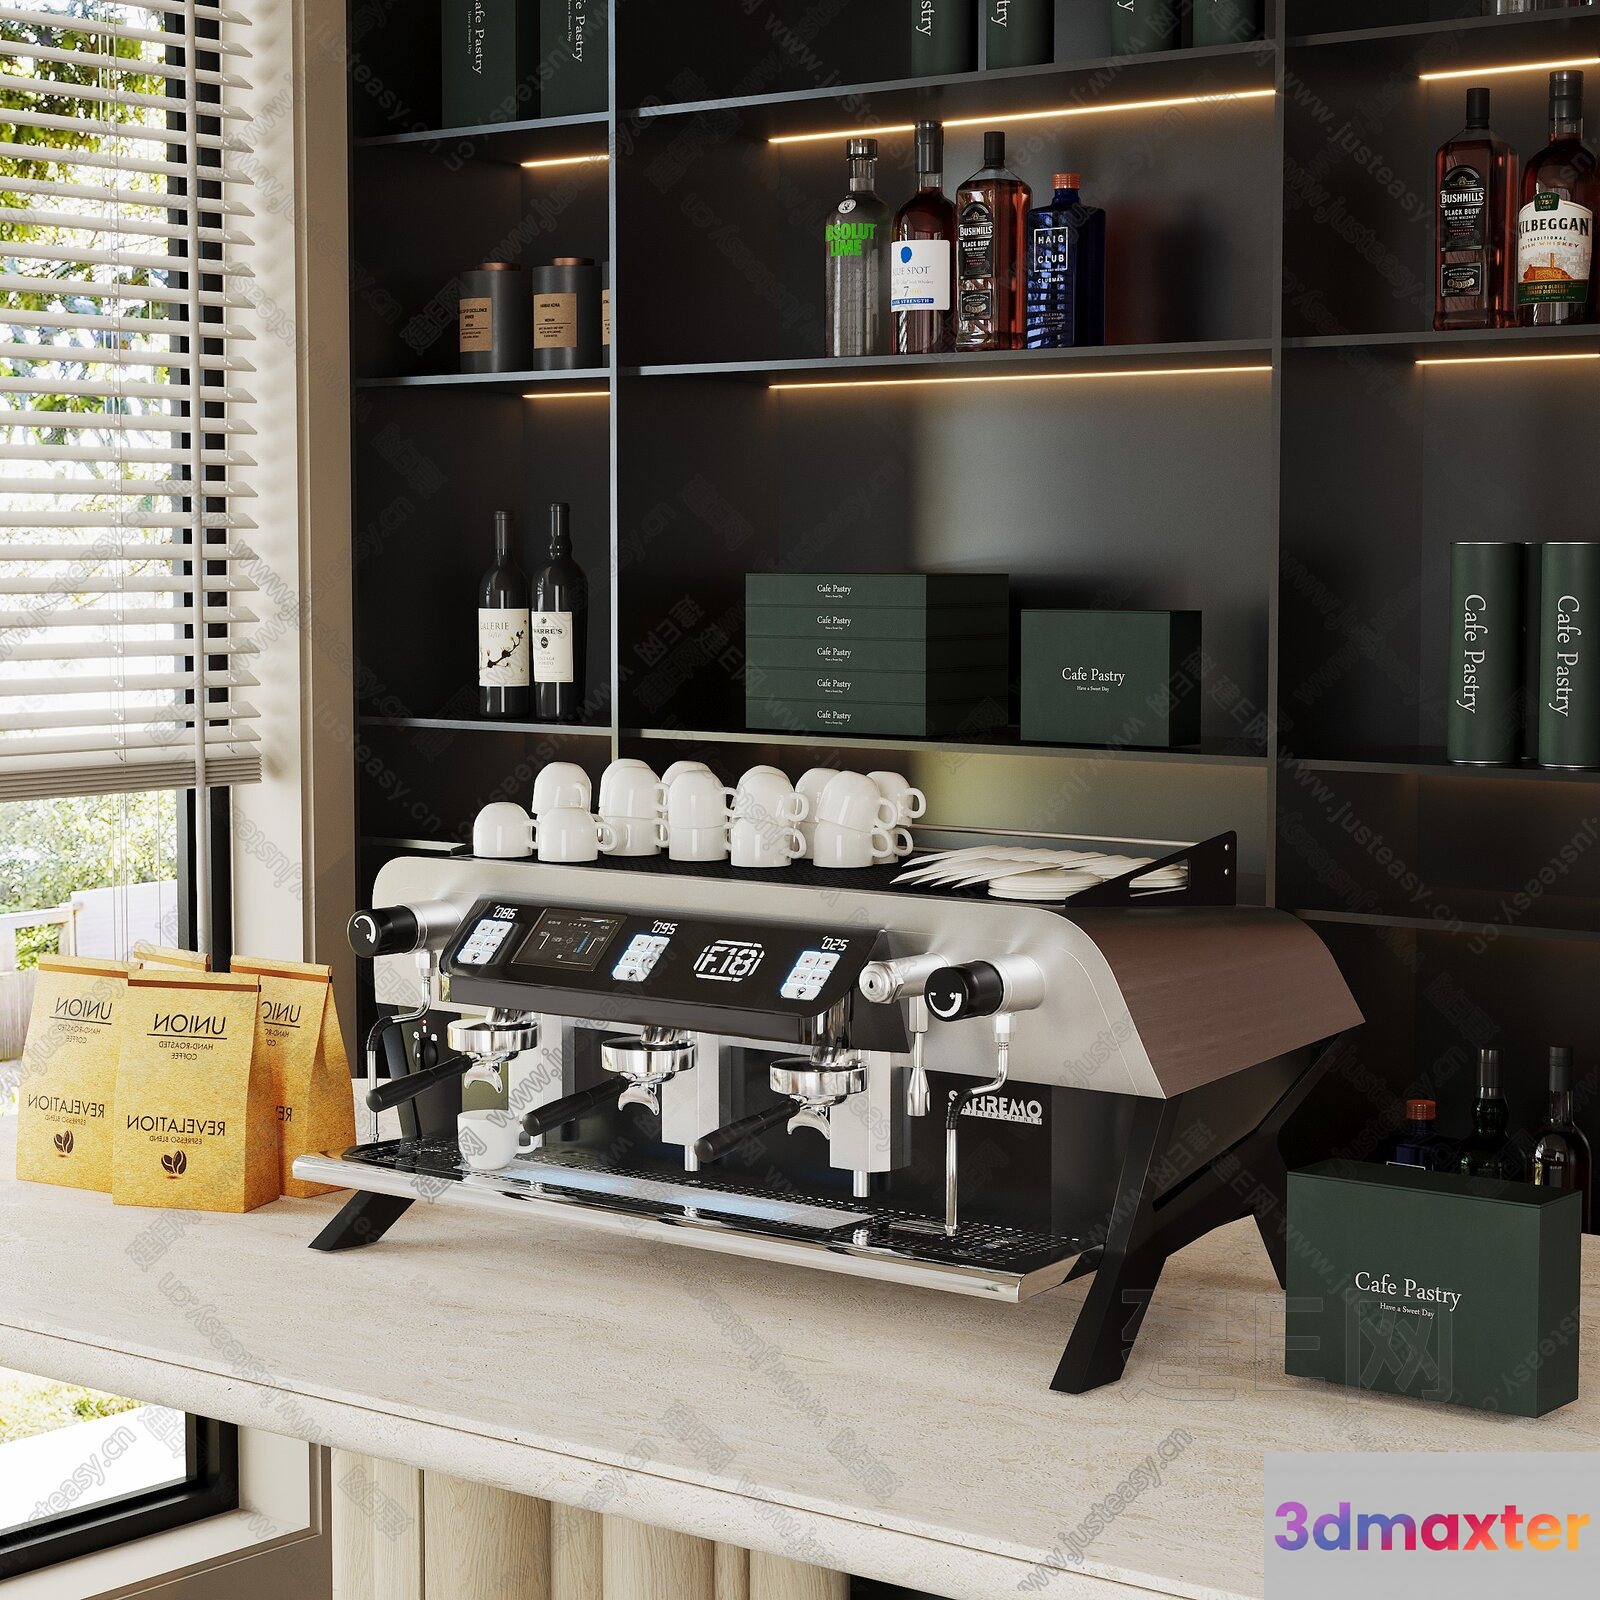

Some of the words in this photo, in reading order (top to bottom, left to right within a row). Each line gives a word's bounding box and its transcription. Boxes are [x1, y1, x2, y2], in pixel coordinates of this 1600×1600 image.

[572, 14, 586, 63] Pastry
[472, 28, 485, 75] Pastry
[1441, 192, 1484, 204] BUSHMILLS
[1444, 209, 1463, 217] BLACK
[1464, 208, 1481, 216] BUSH
[959, 225, 993, 236] BUSHMILLS
[1037, 235, 1064, 245] HAIG
[1538, 241, 1580, 249] WHISKEY
[830, 240, 863, 257] LIME
[1037, 254, 1065, 264] CLUB
[907, 266, 929, 275] SPOT
[903, 286, 909, 297] 7
[816, 584, 831, 593] Cafe
[832, 584, 852, 596] Pastry
[816, 615, 831, 624] Cafe
[832, 615, 852, 627] Pastry
[1464, 594, 1488, 642] Cafe
[1557, 595, 1582, 643] Cafe
[816, 647, 831, 656] Cafe
[832, 647, 852, 659] Pastry
[1062, 666, 1087, 681] Cafe
[1091, 668, 1126, 687] Pastry
[1456, 649, 1485, 714] Pastry
[816, 678, 831, 687] Cafe
[832, 678, 852, 690] Pastry
[1548, 652, 1579, 717] Pastry
[816, 710, 831, 719] Cafe
[832, 710, 852, 722] Pastry
[1355, 1271, 1398, 1296] Cafe
[1403, 1278, 1462, 1312] Pastry
[1380, 1302, 1396, 1312] Have
[1402, 1305, 1420, 1316] Sweet
[1421, 1308, 1435, 1320] Day
